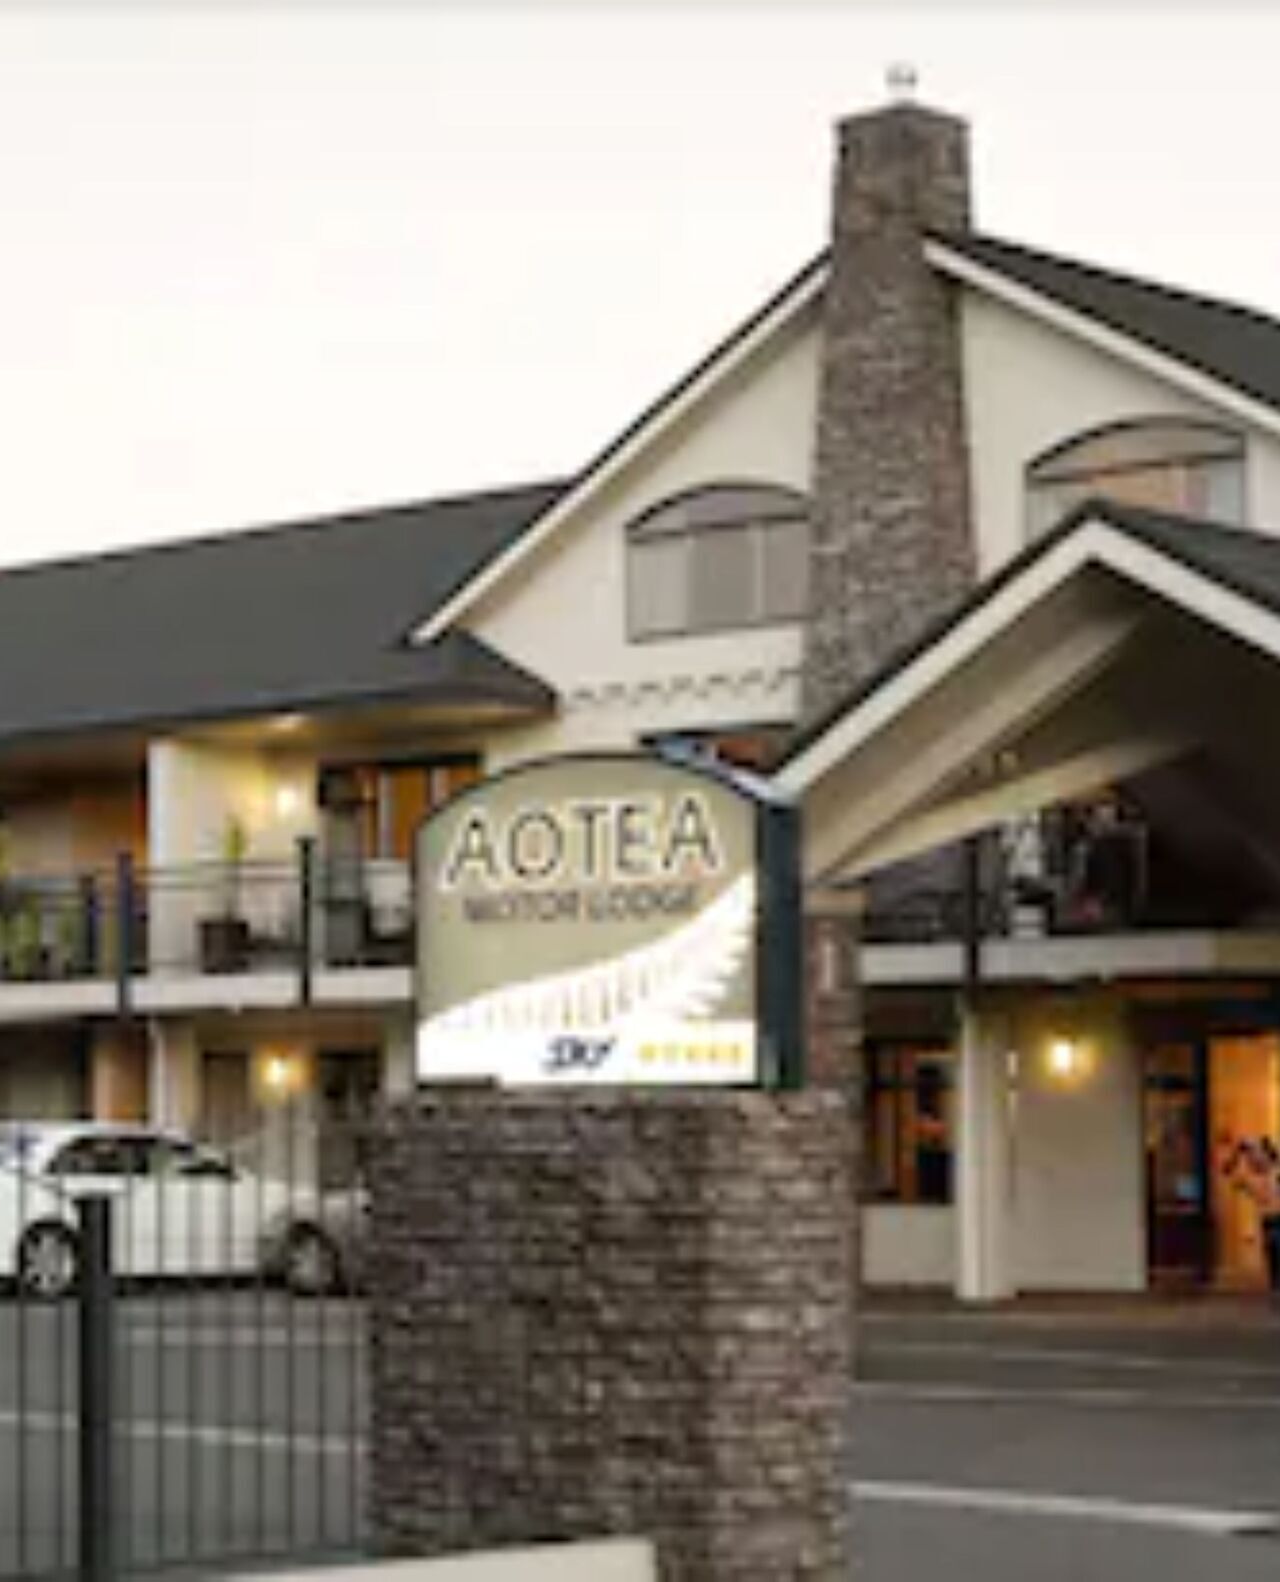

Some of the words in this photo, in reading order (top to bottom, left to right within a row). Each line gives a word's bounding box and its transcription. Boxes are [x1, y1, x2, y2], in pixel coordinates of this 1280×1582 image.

[442, 796, 721, 884] AOTEA
[463, 890, 579, 922] MOTOR
[587, 882, 697, 921] LODGE
